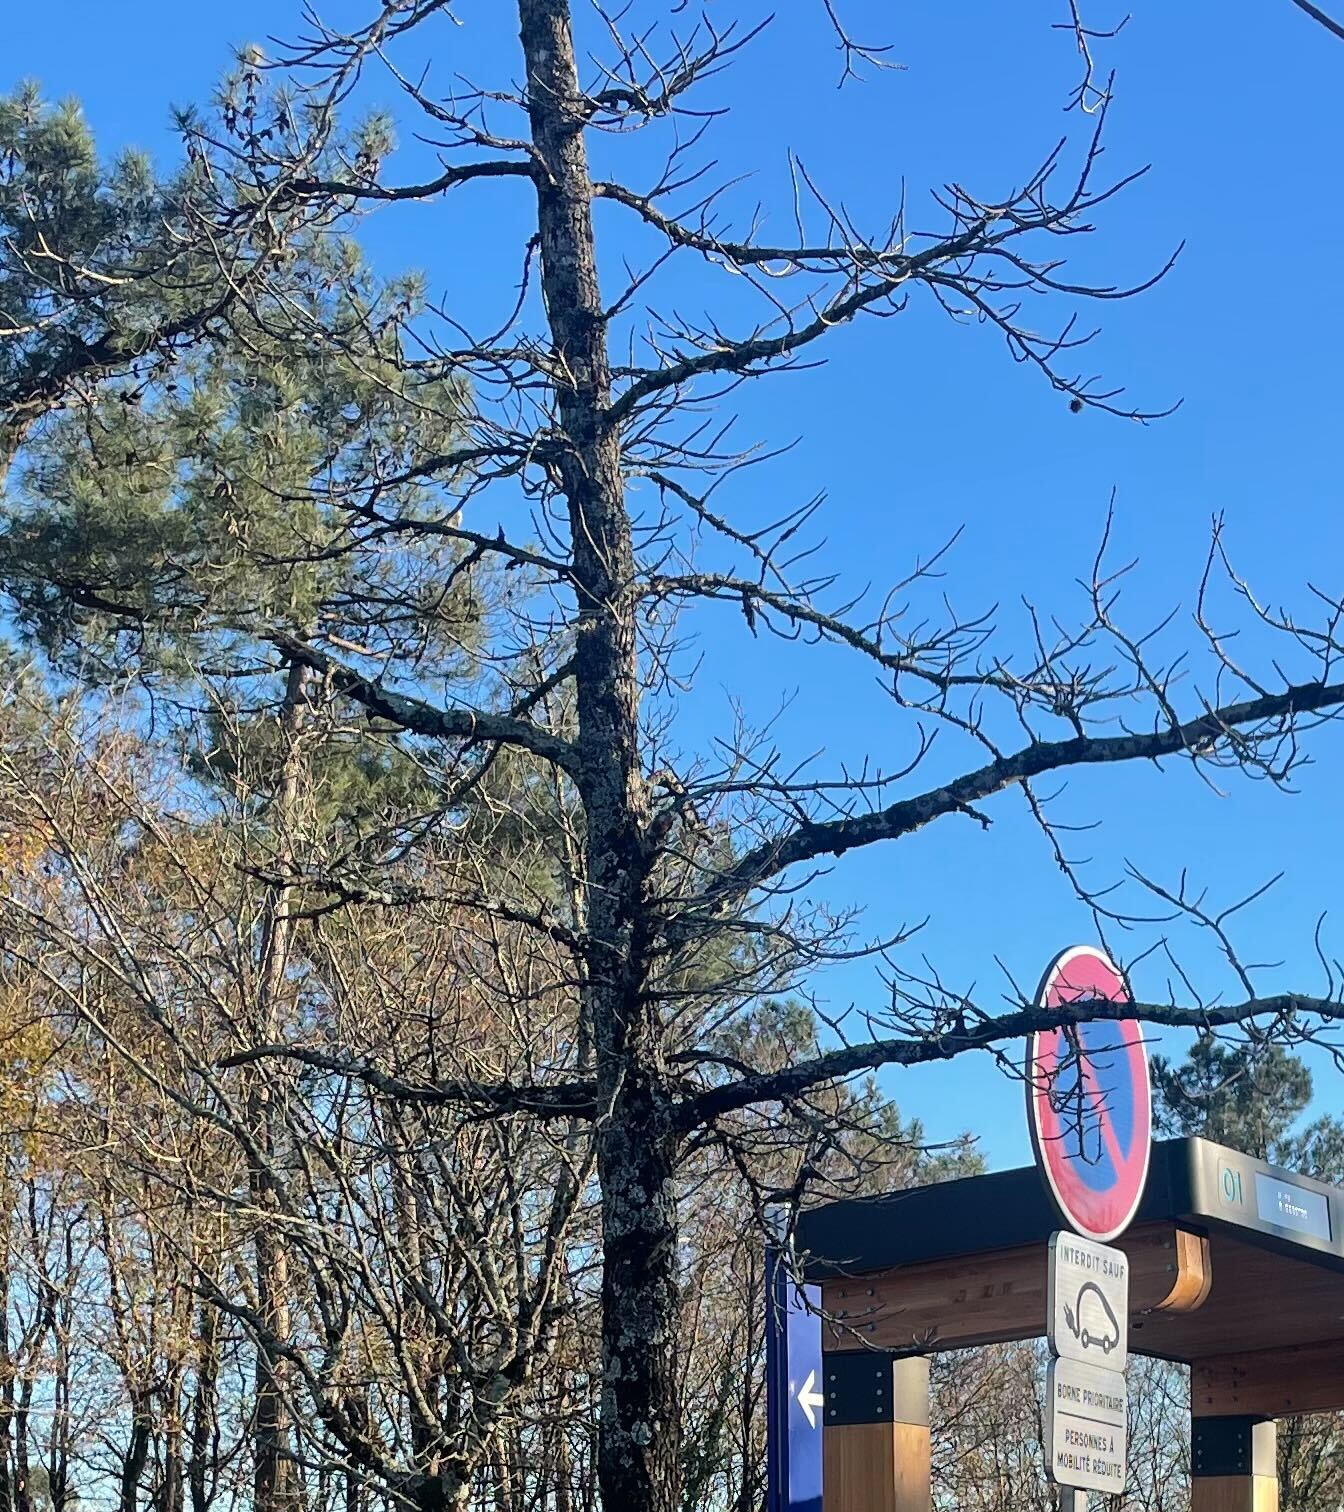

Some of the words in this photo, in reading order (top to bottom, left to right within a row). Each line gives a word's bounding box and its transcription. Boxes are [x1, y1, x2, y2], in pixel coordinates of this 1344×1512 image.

[1060, 1244, 1100, 1273] INTERDIT
[1102, 1259, 1125, 1280] SAUF
[1057, 1383, 1081, 1403] BORNE
[1082, 1389, 1124, 1413] PRIORITAIRE
[1065, 1428, 1107, 1452] PERSONNES
[1057, 1450, 1091, 1473] MOBILITÉ
